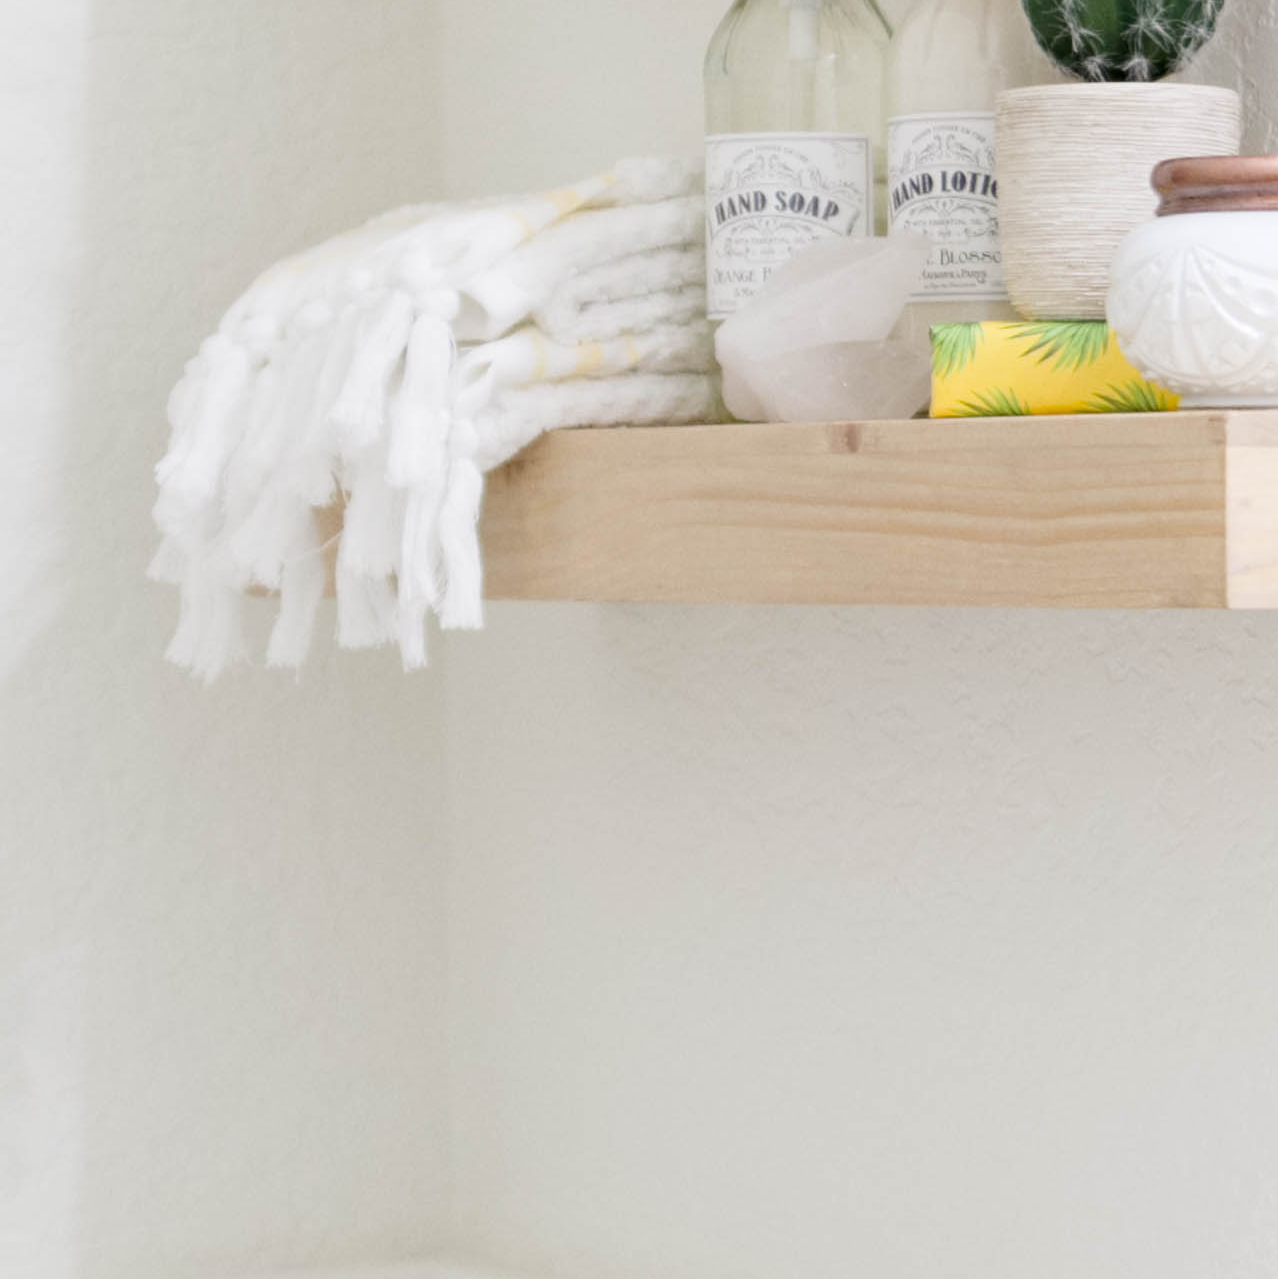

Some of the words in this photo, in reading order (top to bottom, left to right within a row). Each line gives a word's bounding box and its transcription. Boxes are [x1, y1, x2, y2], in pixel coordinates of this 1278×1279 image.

[714, 190, 767, 226] HAND
[774, 189, 840, 222] SOAP
[891, 171, 934, 210] HAND
[940, 248, 1002, 266] BLOSSO
